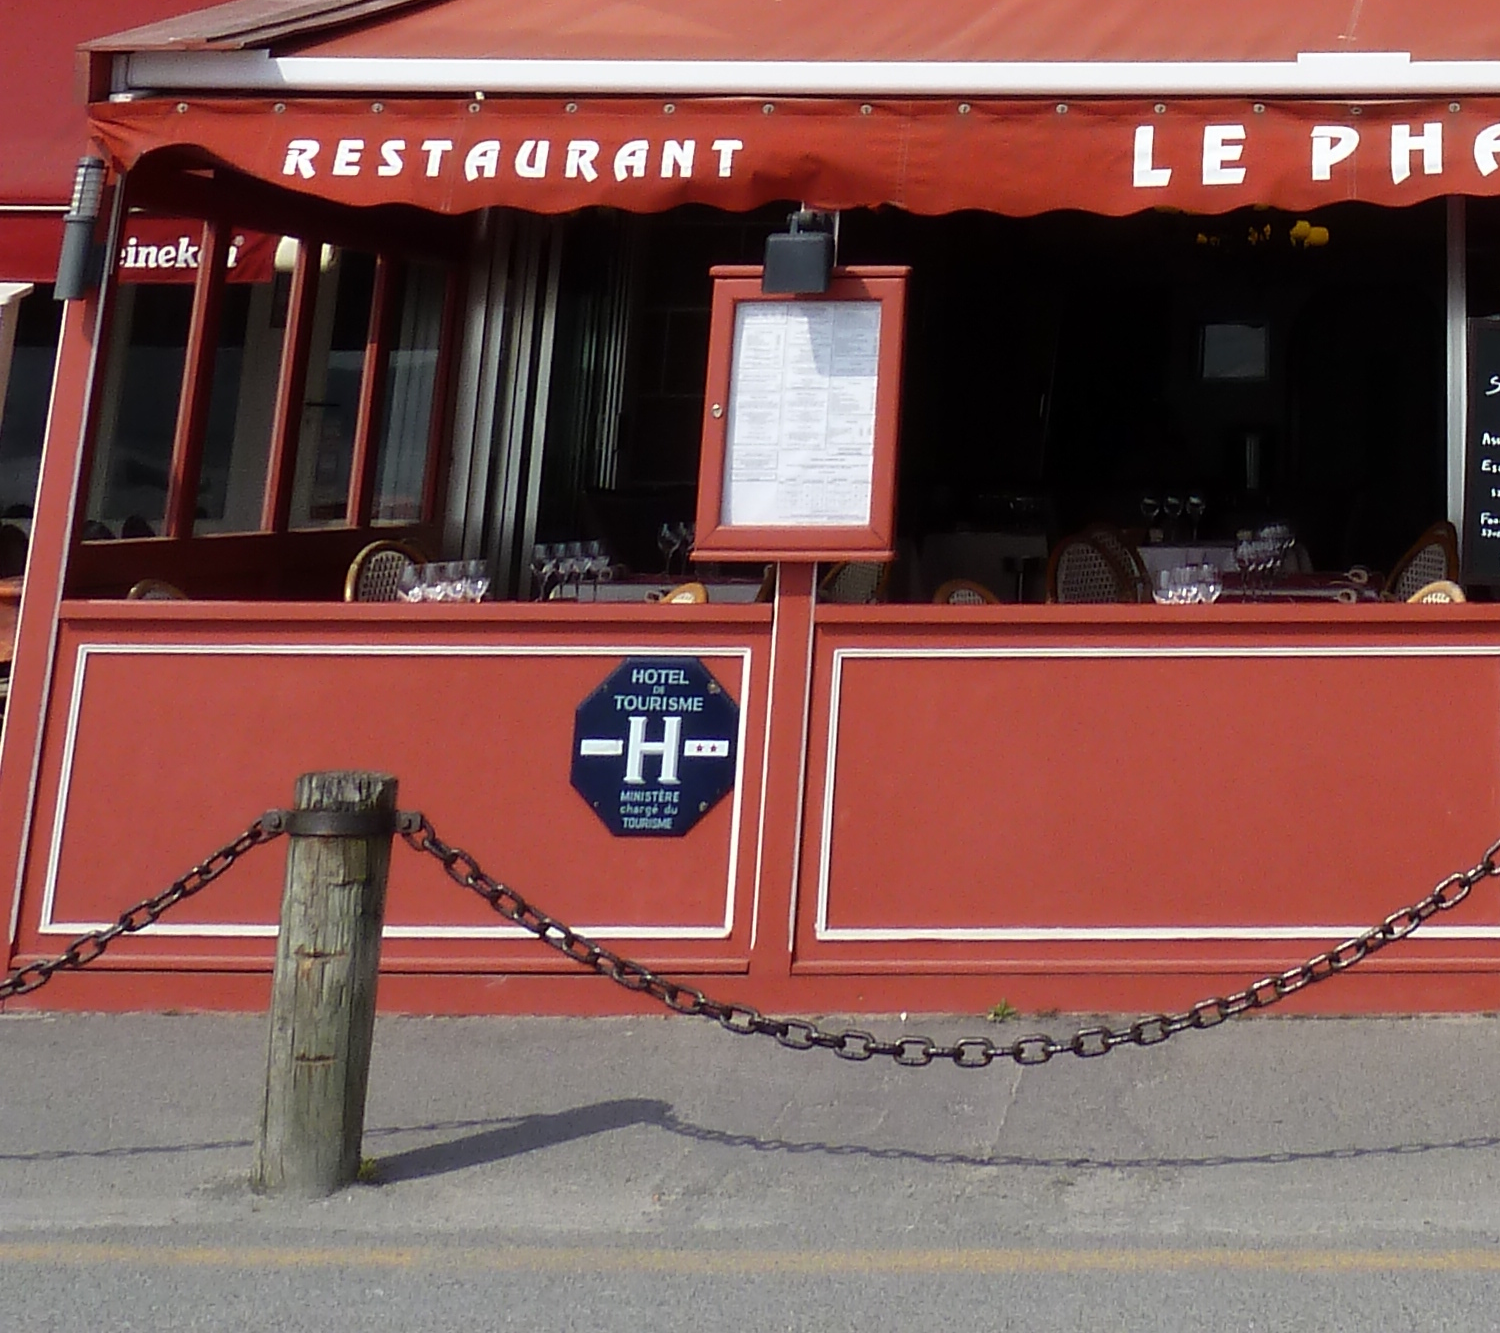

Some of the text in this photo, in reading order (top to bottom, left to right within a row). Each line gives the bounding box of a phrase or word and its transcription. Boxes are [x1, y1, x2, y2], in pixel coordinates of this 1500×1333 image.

[282, 137, 744, 183] RESTAURANT
[1132, 123, 1248, 188] LE
[631, 668, 690, 685] HOTEL
[652, 685, 665, 695] DE
[613, 694, 704, 712] TOURISME
[623, 715, 683, 785] H
[619, 789, 680, 803] MINISTÈRE
[619, 804, 678, 817] chargé du
[622, 816, 674, 830] TOURISME
